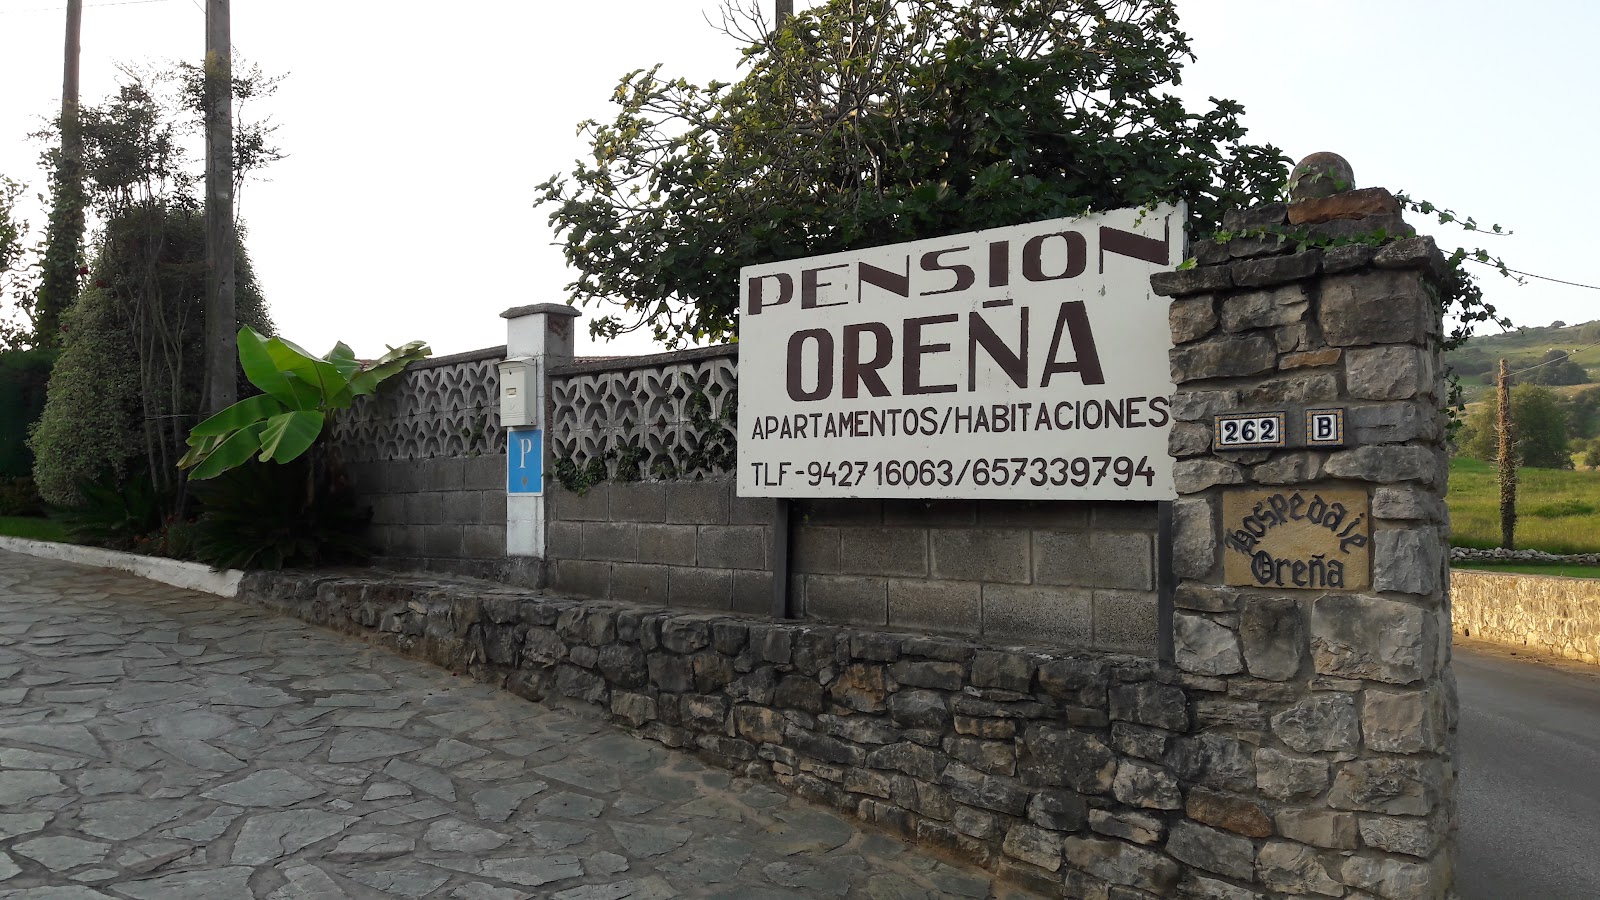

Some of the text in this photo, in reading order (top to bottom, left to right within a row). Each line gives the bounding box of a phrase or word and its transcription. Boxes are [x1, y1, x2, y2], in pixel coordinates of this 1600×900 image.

[748, 215, 1170, 316] PENSION
[786, 299, 1106, 402] OREÑA
[1224, 419, 1275, 443] 262
[1316, 416, 1333, 438] B
[518, 438, 532, 469] P
[1251, 550, 1344, 588] Oreña
